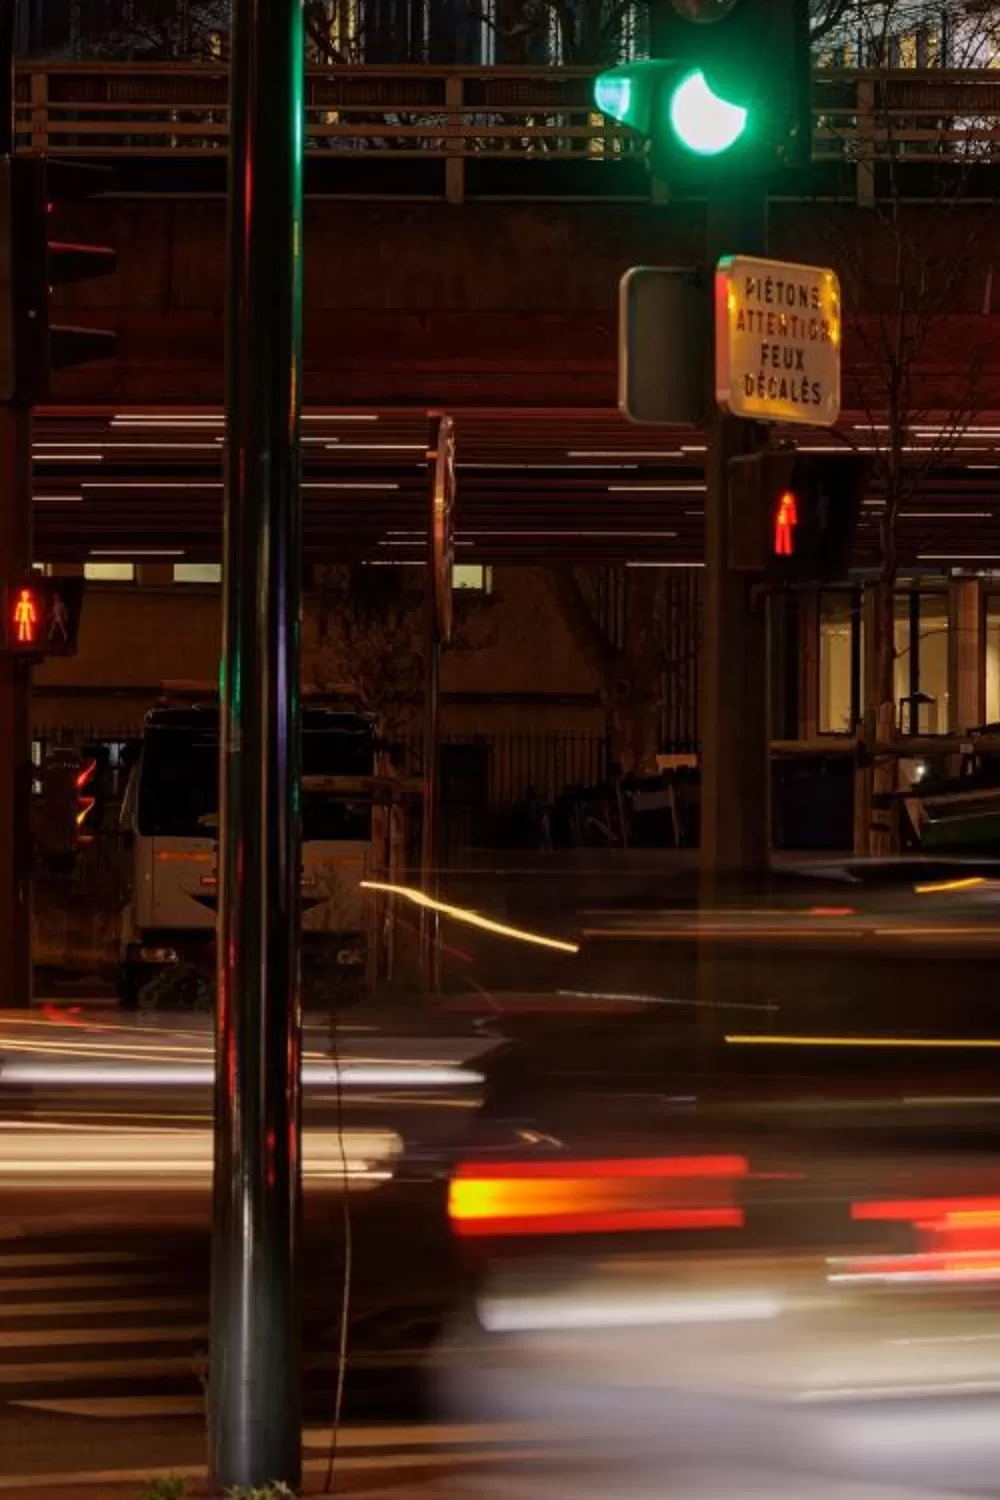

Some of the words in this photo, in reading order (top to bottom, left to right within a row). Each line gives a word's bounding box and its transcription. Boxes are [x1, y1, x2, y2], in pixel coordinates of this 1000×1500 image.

[745, 275, 820, 309] PIÉTONS
[736, 308, 830, 341] ATTENTION
[760, 343, 805, 372] FEUX
[744, 371, 822, 405] DÉCALÉS
